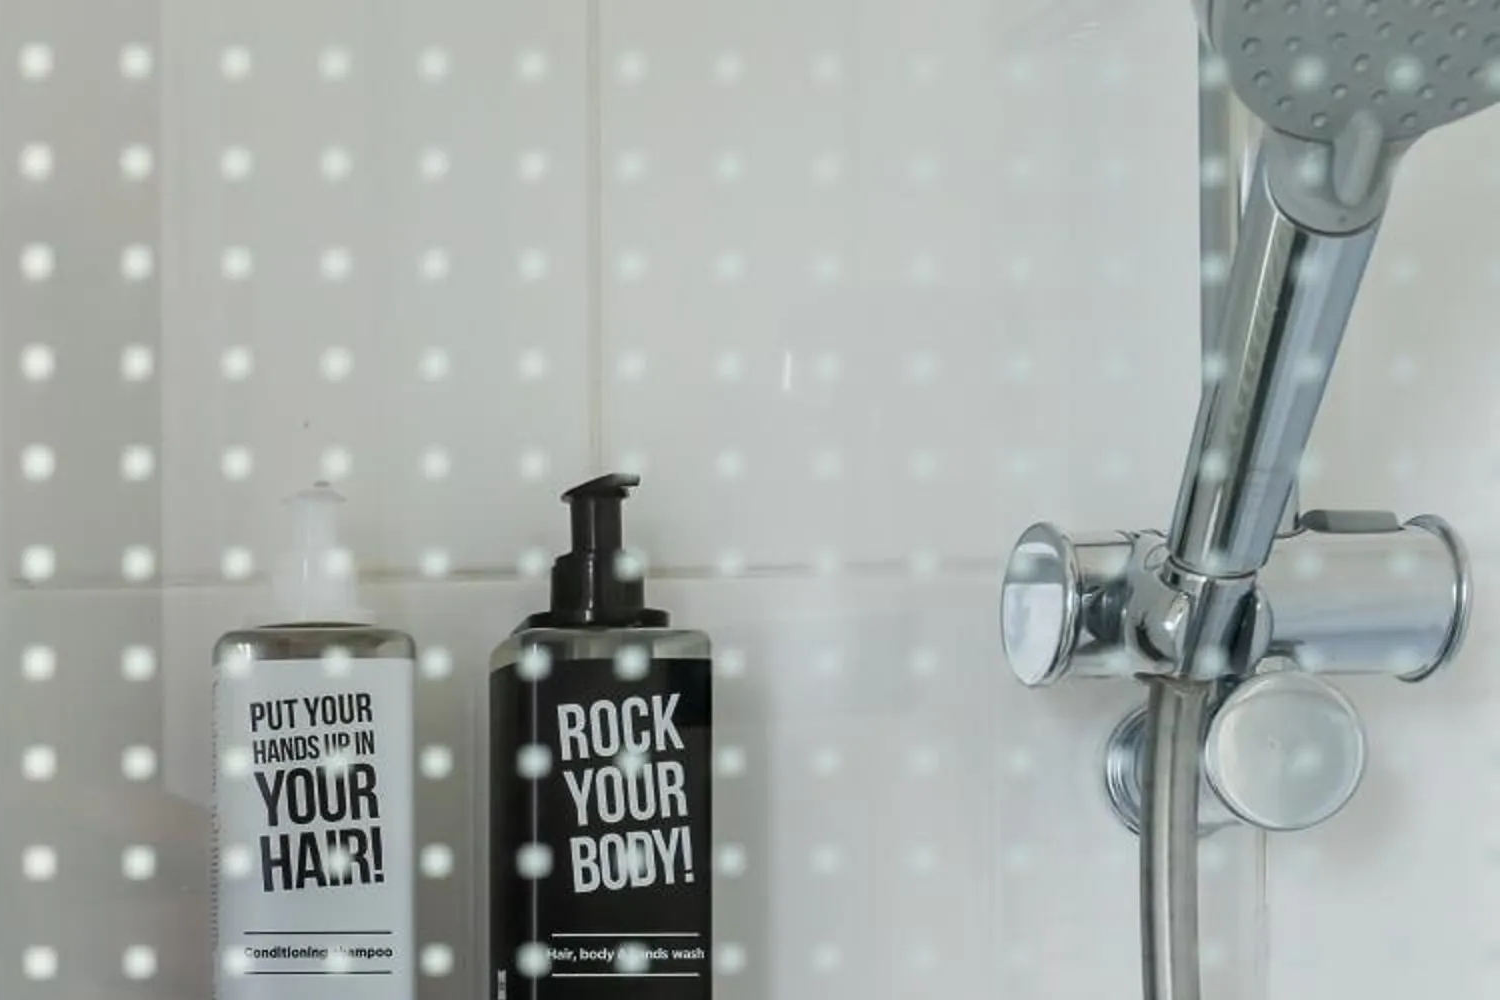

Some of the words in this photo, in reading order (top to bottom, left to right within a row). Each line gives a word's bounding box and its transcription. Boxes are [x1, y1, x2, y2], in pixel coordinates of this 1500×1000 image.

[250, 698, 298, 733] PUT
[303, 693, 374, 727] YOUR
[557, 693, 685, 761] ROCK
[253, 734, 320, 764] HANDS
[354, 730, 376, 756] IN
[254, 763, 381, 826] YOUR
[563, 761, 689, 827] YOUR
[259, 826, 385, 892] HAIR!
[569, 826, 695, 893] BODY!
[244, 944, 329, 961] Conditioning
[333, 945, 393, 960] ampoo
[547, 946, 577, 962] Hair,
[579, 946, 615, 963] body
[672, 946, 705, 961] wash
